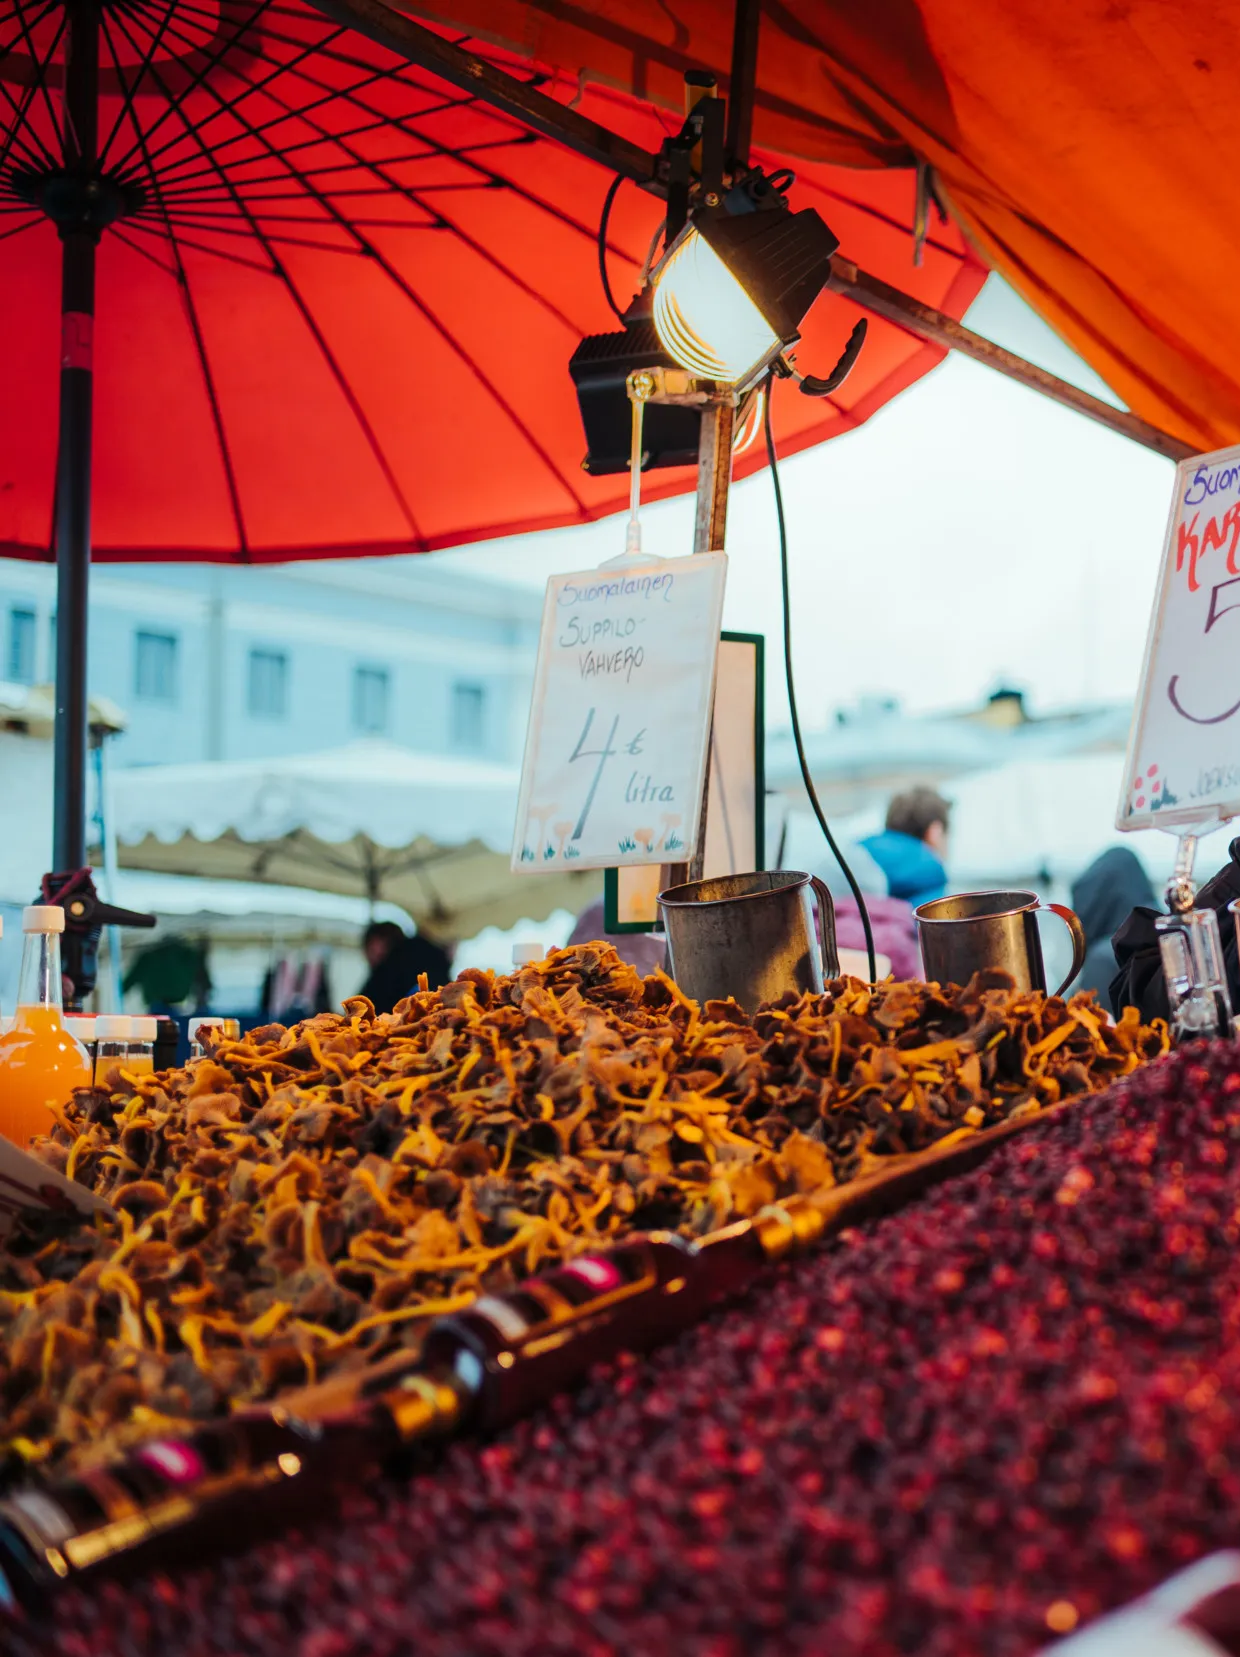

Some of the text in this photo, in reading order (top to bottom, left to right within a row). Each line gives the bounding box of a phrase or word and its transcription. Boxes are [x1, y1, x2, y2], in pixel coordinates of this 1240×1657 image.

[557, 573, 674, 608] Suomalainen
[579, 646, 645, 683] VAHVERO
[568, 707, 648, 841] 4 €
[624, 770, 675, 804] litra
